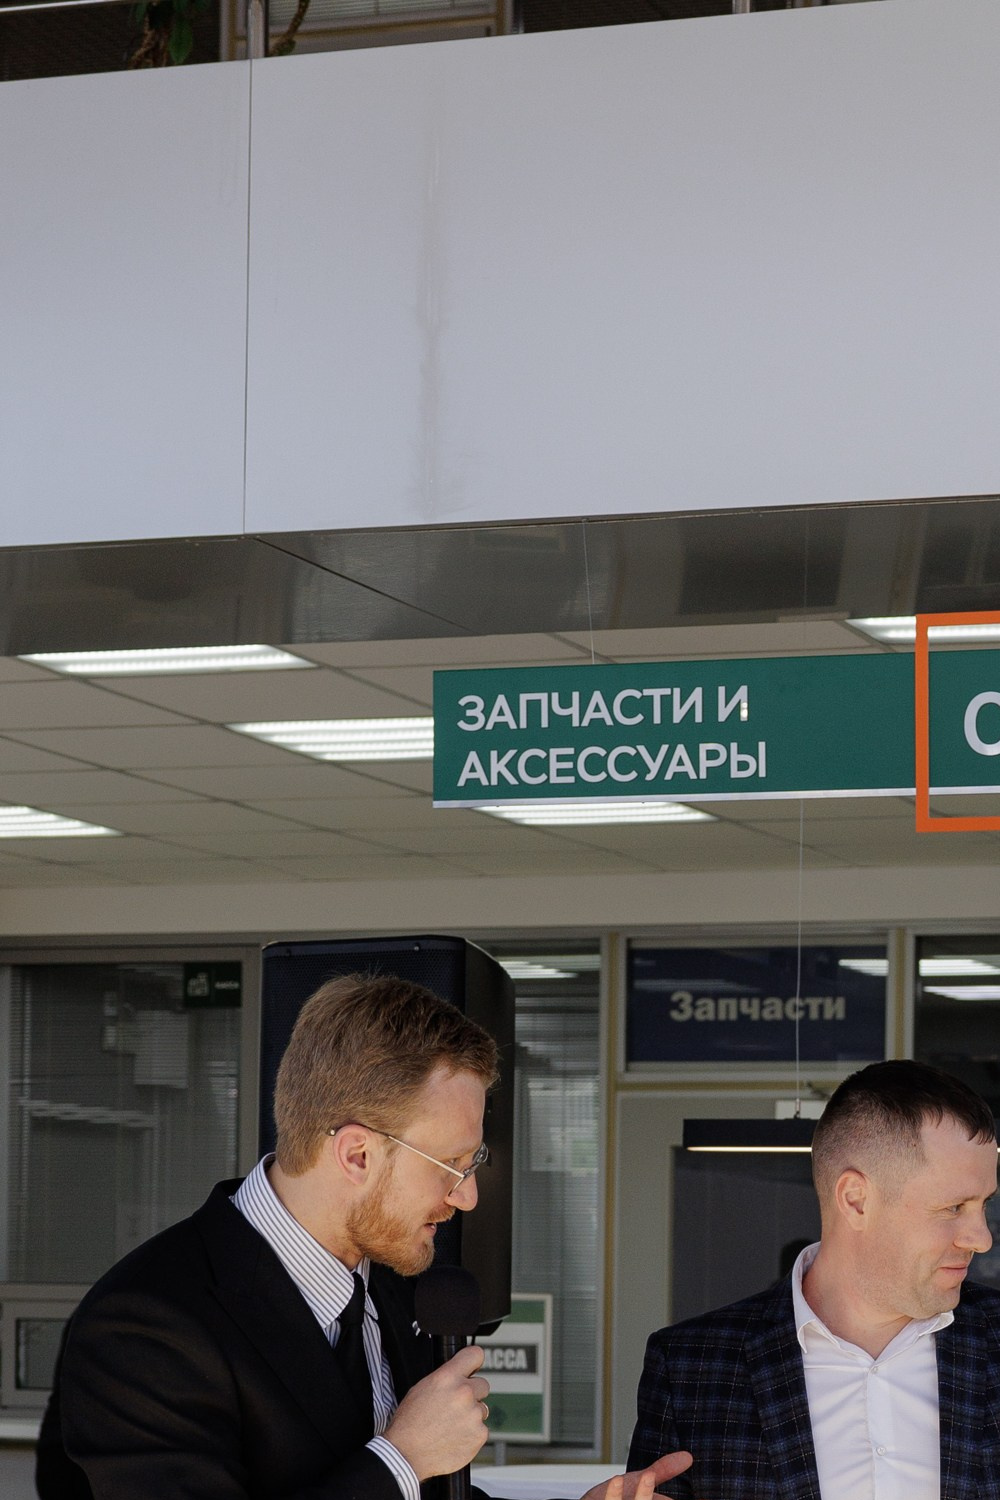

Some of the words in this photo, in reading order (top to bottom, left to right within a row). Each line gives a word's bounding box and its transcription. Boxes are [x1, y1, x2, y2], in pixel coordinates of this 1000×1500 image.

[457, 686, 703, 731] ЗАПЧАСТИ
[717, 685, 748, 723] И
[457, 741, 766, 787] АКСЕССУАРЫ
[669, 990, 847, 1022] Запчасти
[484, 1348, 529, 1370] АССА
